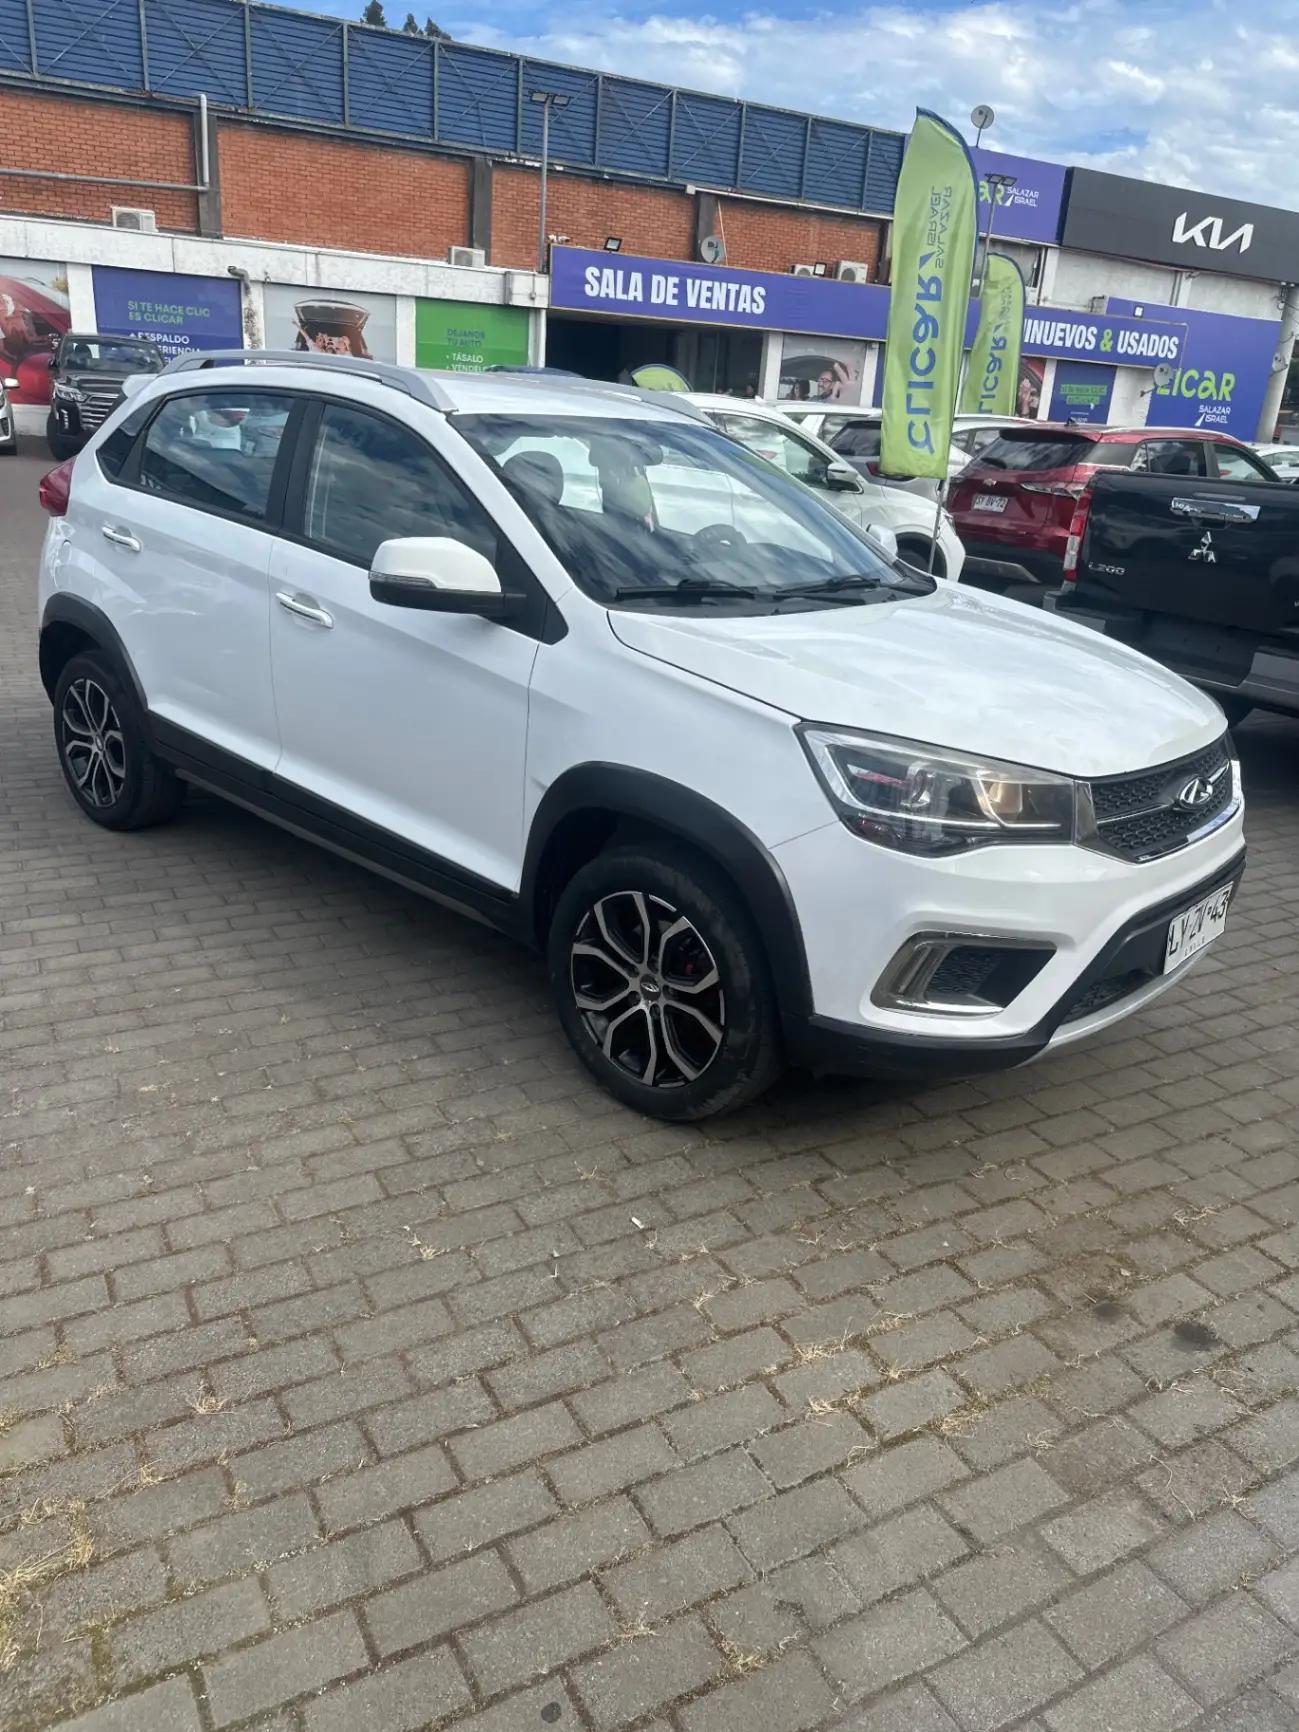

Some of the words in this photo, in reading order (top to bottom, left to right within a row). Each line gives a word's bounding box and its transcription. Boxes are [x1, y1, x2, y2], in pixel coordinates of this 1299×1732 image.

[1007, 187, 1039, 199] SALAZAR
[1014, 196, 1038, 208] ISRAEL
[1172, 212, 1254, 254] KIA
[584, 266, 643, 302] SALA
[650, 275, 680, 306] DE
[686, 278, 766, 315] VENTAS
[127, 300, 138, 310] SI
[139, 302, 153, 312] TE
[154, 304, 184, 315] HACE
[185, 306, 210, 317] CLIC
[144, 312, 184, 324] CLICAR
[1100, 329, 1113, 352] &
[1117, 330, 1179, 359] USADOS
[1198, 405, 1231, 415] SALAZAR
[1204, 414, 1228, 424] ISRAEL
[1088, 561, 1126, 576] L200
